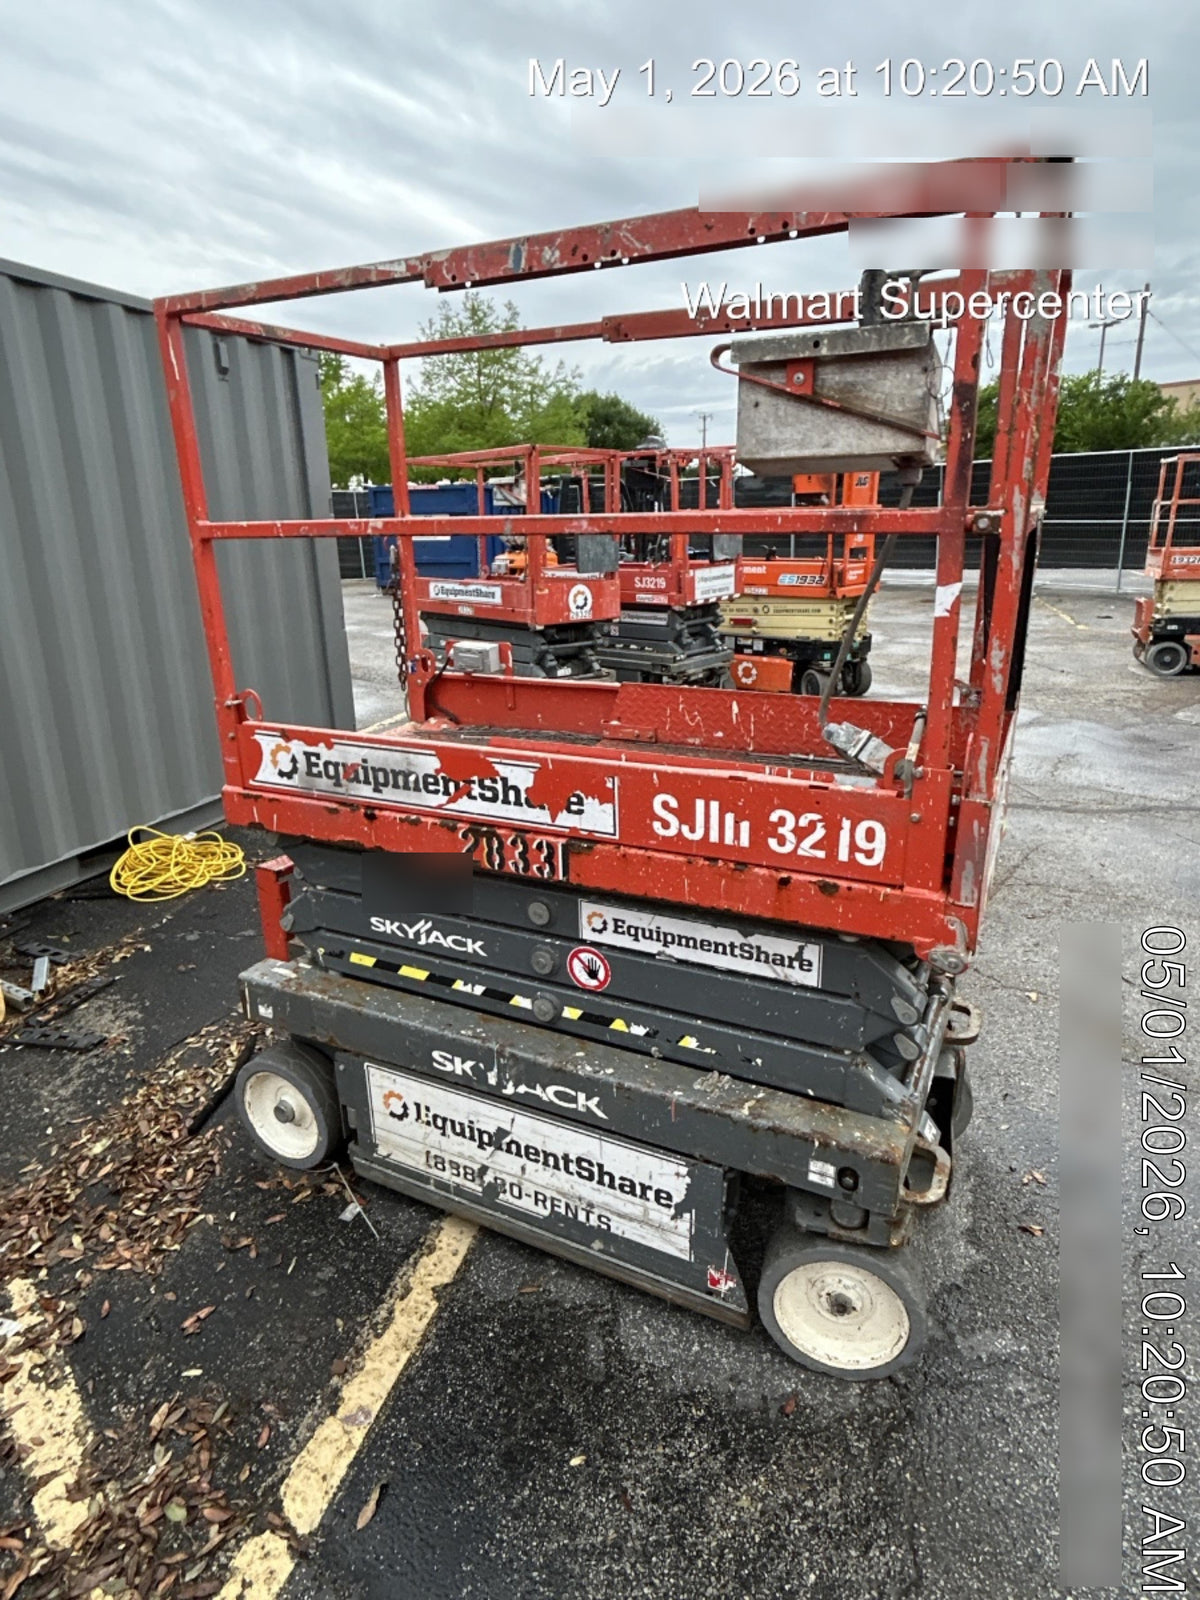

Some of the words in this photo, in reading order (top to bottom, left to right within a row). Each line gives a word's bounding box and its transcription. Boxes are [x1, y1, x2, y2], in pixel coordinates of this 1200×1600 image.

[634, 576, 666, 589] SJ3219
[779, 575, 825, 585] ES1932
[303, 751, 584, 815] EquipmentShe
[767, 809, 887, 866] 3219
[370, 916, 488, 957] SKYJACK
[612, 918, 814, 973] EquipmentShare
